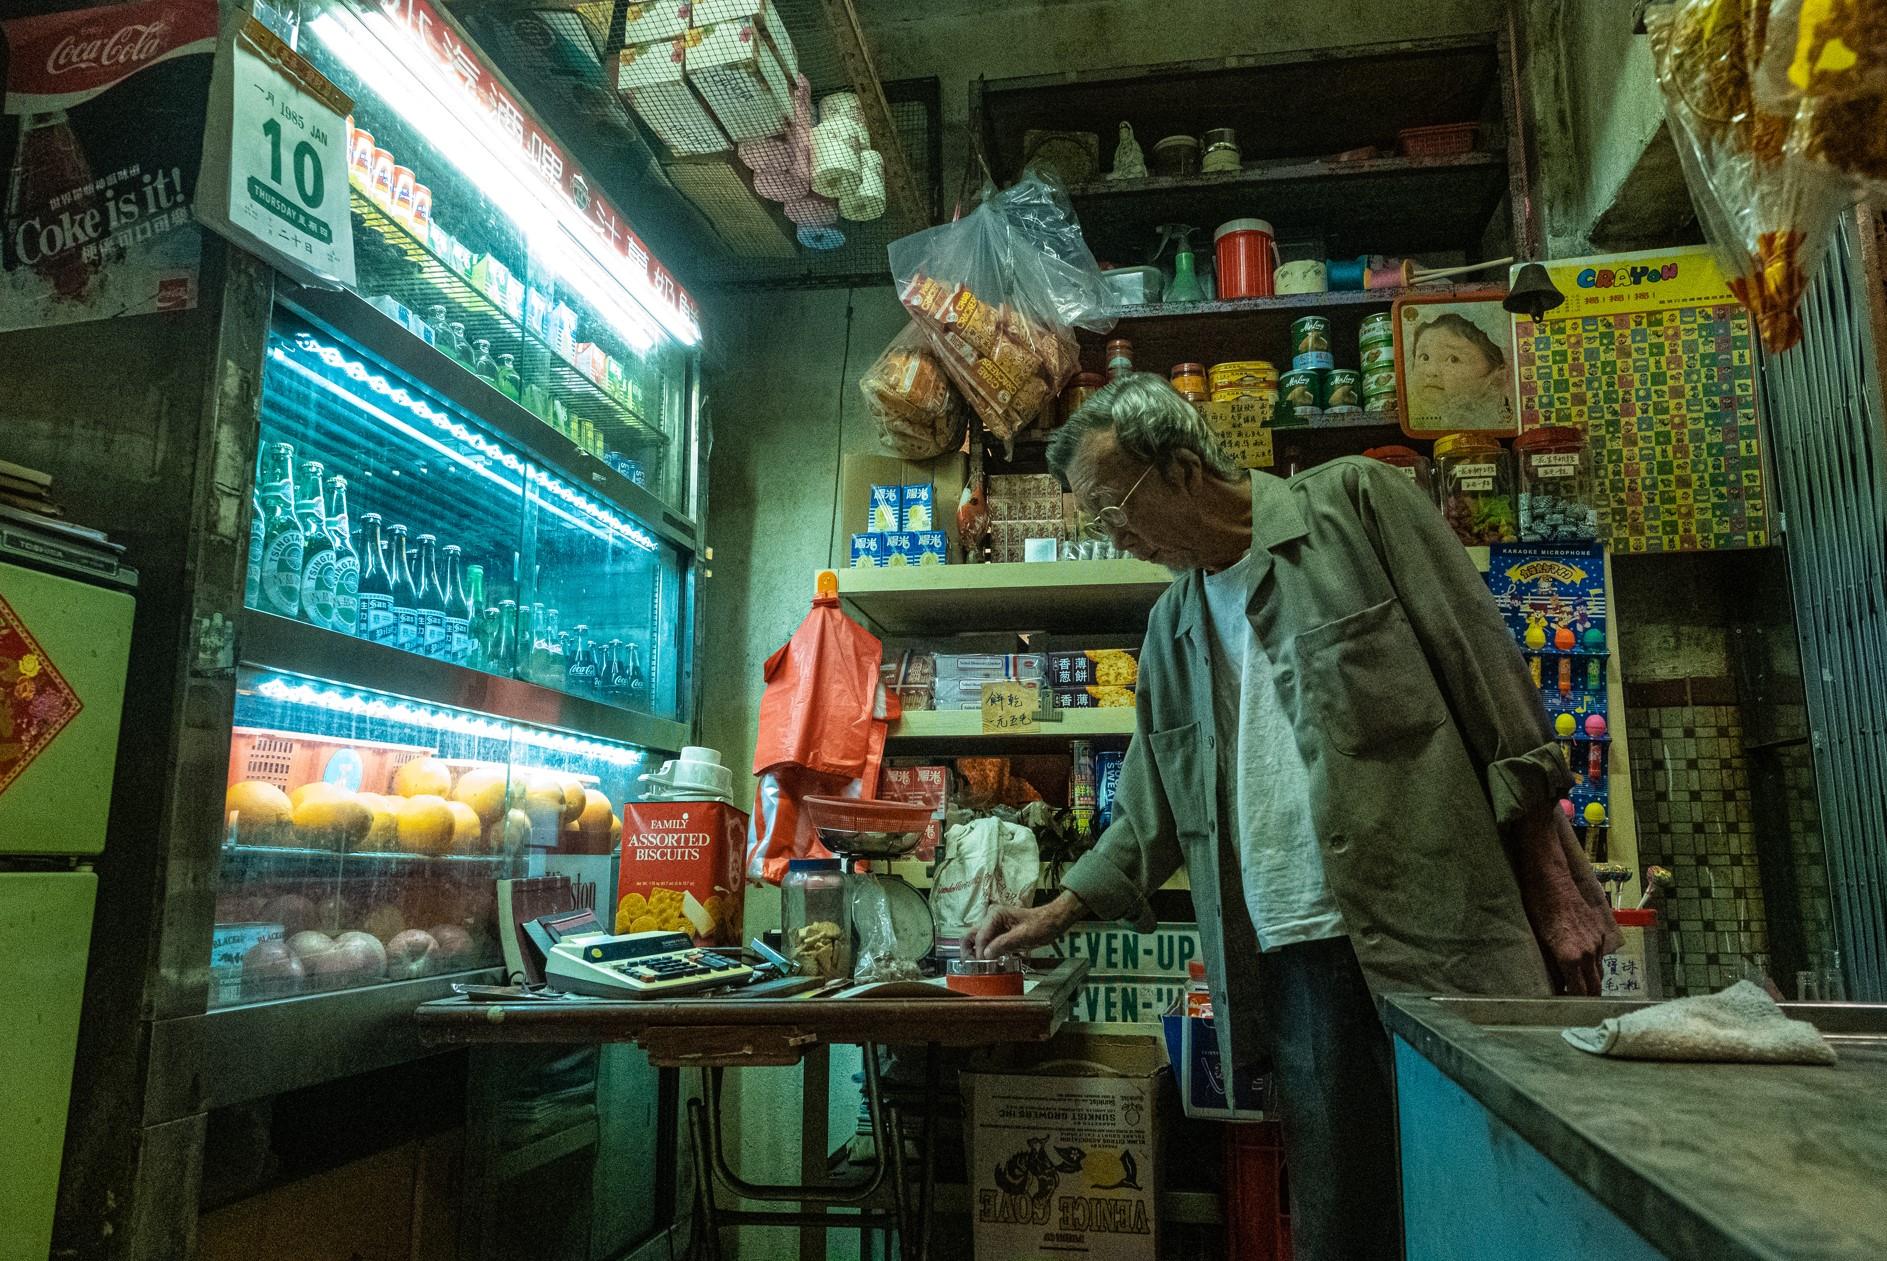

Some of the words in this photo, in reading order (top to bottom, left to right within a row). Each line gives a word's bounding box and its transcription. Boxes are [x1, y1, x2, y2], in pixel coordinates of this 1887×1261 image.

[47, 21, 164, 75] Coca-Cola
[253, 83, 276, 107] 一月
[280, 101, 305, 130] 1985
[310, 124, 328, 147] JAN
[262, 117, 325, 210] 10
[254, 184, 297, 223] THURSDAY
[16, 208, 102, 265] Coke
[105, 189, 139, 227] is
[142, 166, 186, 214] it!
[278, 228, 313, 254] 二十日
[1577, 263, 1678, 289] CRAYON
[906, 487, 929, 501] 陽光
[270, 531, 304, 562] TSINGTA
[855, 537, 878, 551] 陽光
[887, 535, 910, 549] 陽光
[918, 534, 942, 548] 陽光
[308, 551, 337, 581] TSINGTA
[369, 600, 387, 609] San
[453, 623, 468, 633] San
[917, 769, 943, 785] 陽光
[650, 819, 689, 831] FAMILY
[627, 833, 711, 848] ASSORTED
[635, 848, 701, 861] BISCUITS
[1071, 1113, 1116, 1121] SUNKIST
[1059, 1196, 1151, 1235] VENICE
